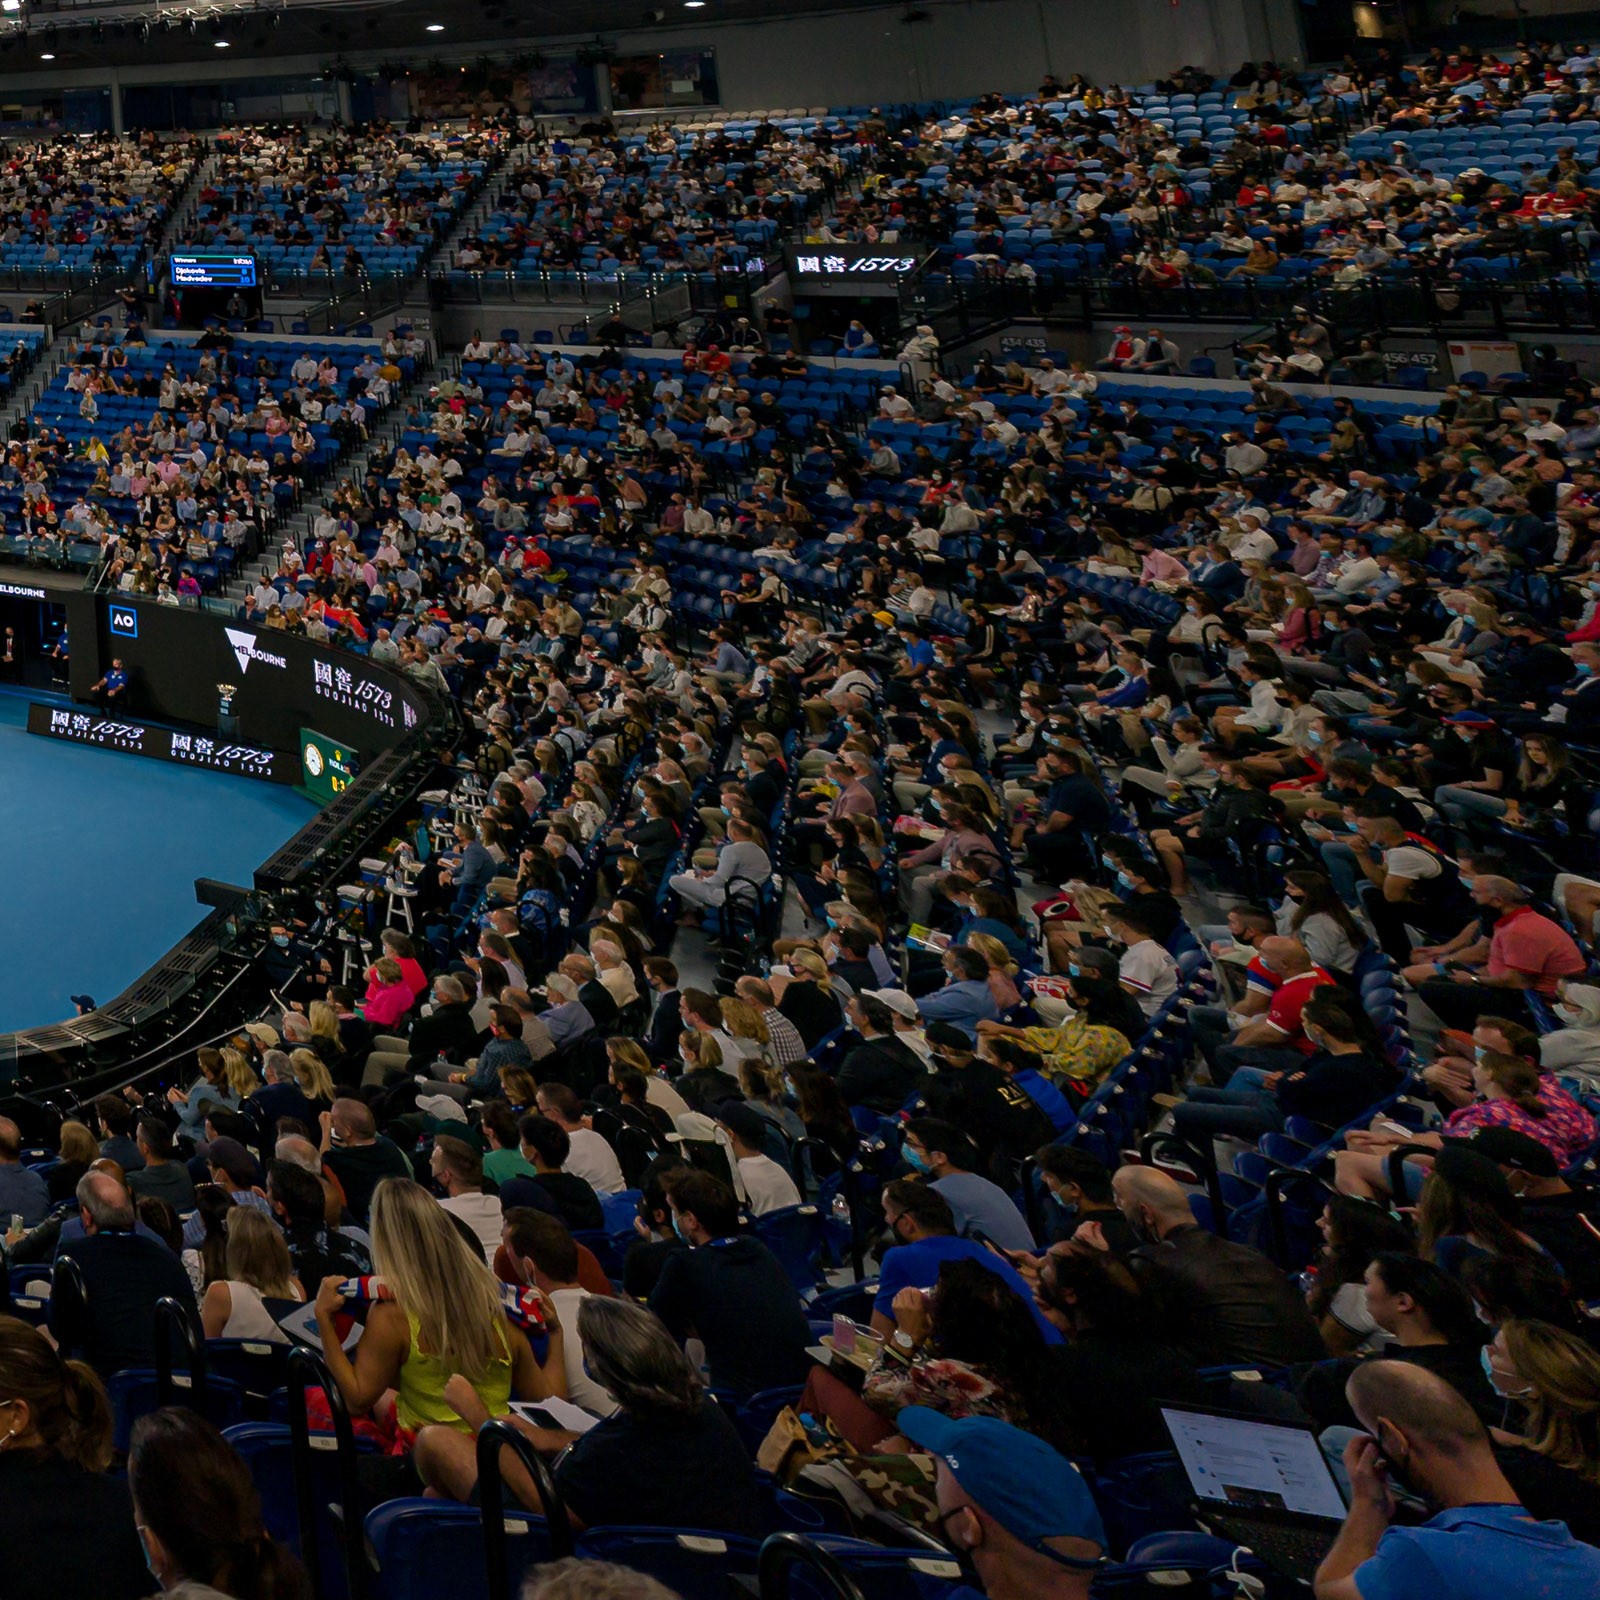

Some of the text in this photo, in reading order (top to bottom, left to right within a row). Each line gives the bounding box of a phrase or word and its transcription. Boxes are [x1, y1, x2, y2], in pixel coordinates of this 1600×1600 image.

[1001, 338, 1046, 348] 434 435
[1382, 352, 1436, 364] 456 457
[114, 613, 134, 627] AO
[233, 644, 286, 669] MELBOURNE
[315, 684, 395, 728] GUOJIAO 1573
[50, 726, 143, 749] GUOJIAO 1573
[171, 750, 272, 775] GUOJIAO 1573
[946, 1454, 959, 1469] AO
